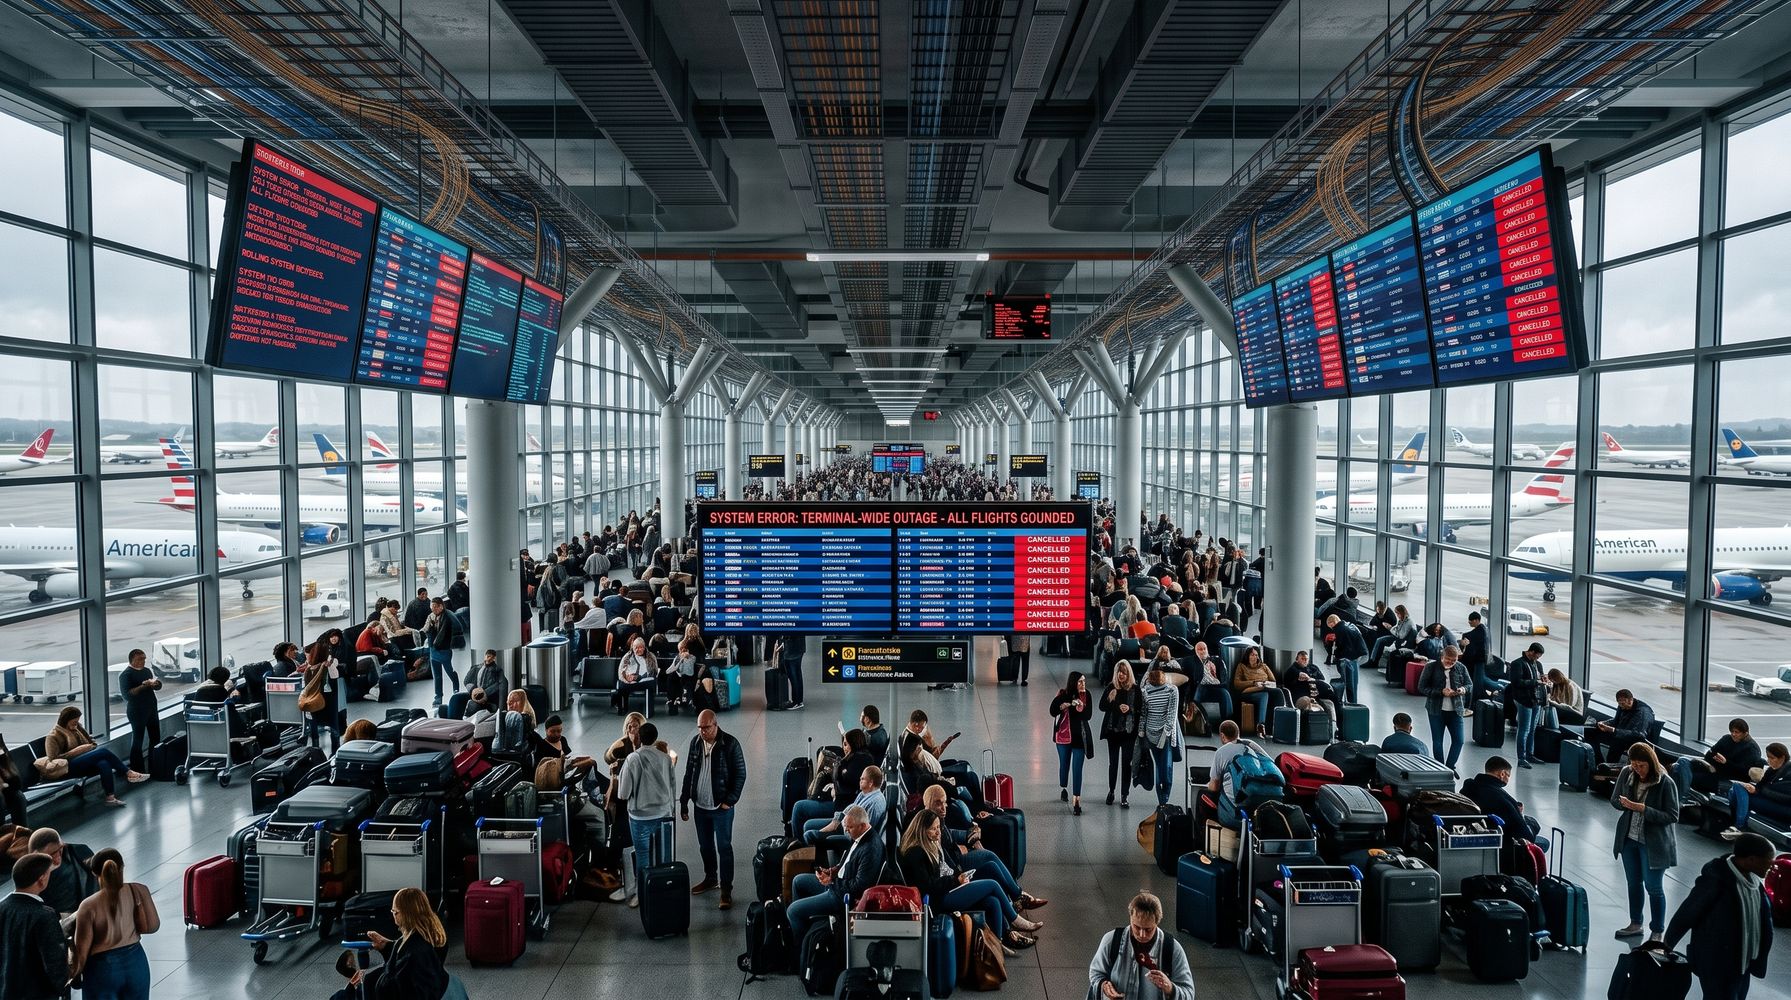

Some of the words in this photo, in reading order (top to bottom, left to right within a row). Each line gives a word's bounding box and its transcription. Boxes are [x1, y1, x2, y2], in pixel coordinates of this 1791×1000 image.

[1504, 212, 1535, 230] CANCELLED
[1510, 268, 1542, 282] CANCELLED
[1514, 291, 1546, 305] CANCELLED
[1519, 333, 1553, 345] CANCELLED
[1521, 347, 1555, 359] CANCELLED
[710, 512, 754, 524] SYSTEM
[758, 512, 799, 524] ERROR:
[801, 512, 890, 524] TERMINAL-WIDE
[893, 512, 937, 524] OUTAGE
[947, 512, 968, 524] ALL
[971, 512, 1017, 524] FLIGHTS
[1020, 512, 1075, 524] GOUNDED
[1594, 537, 1657, 548] American
